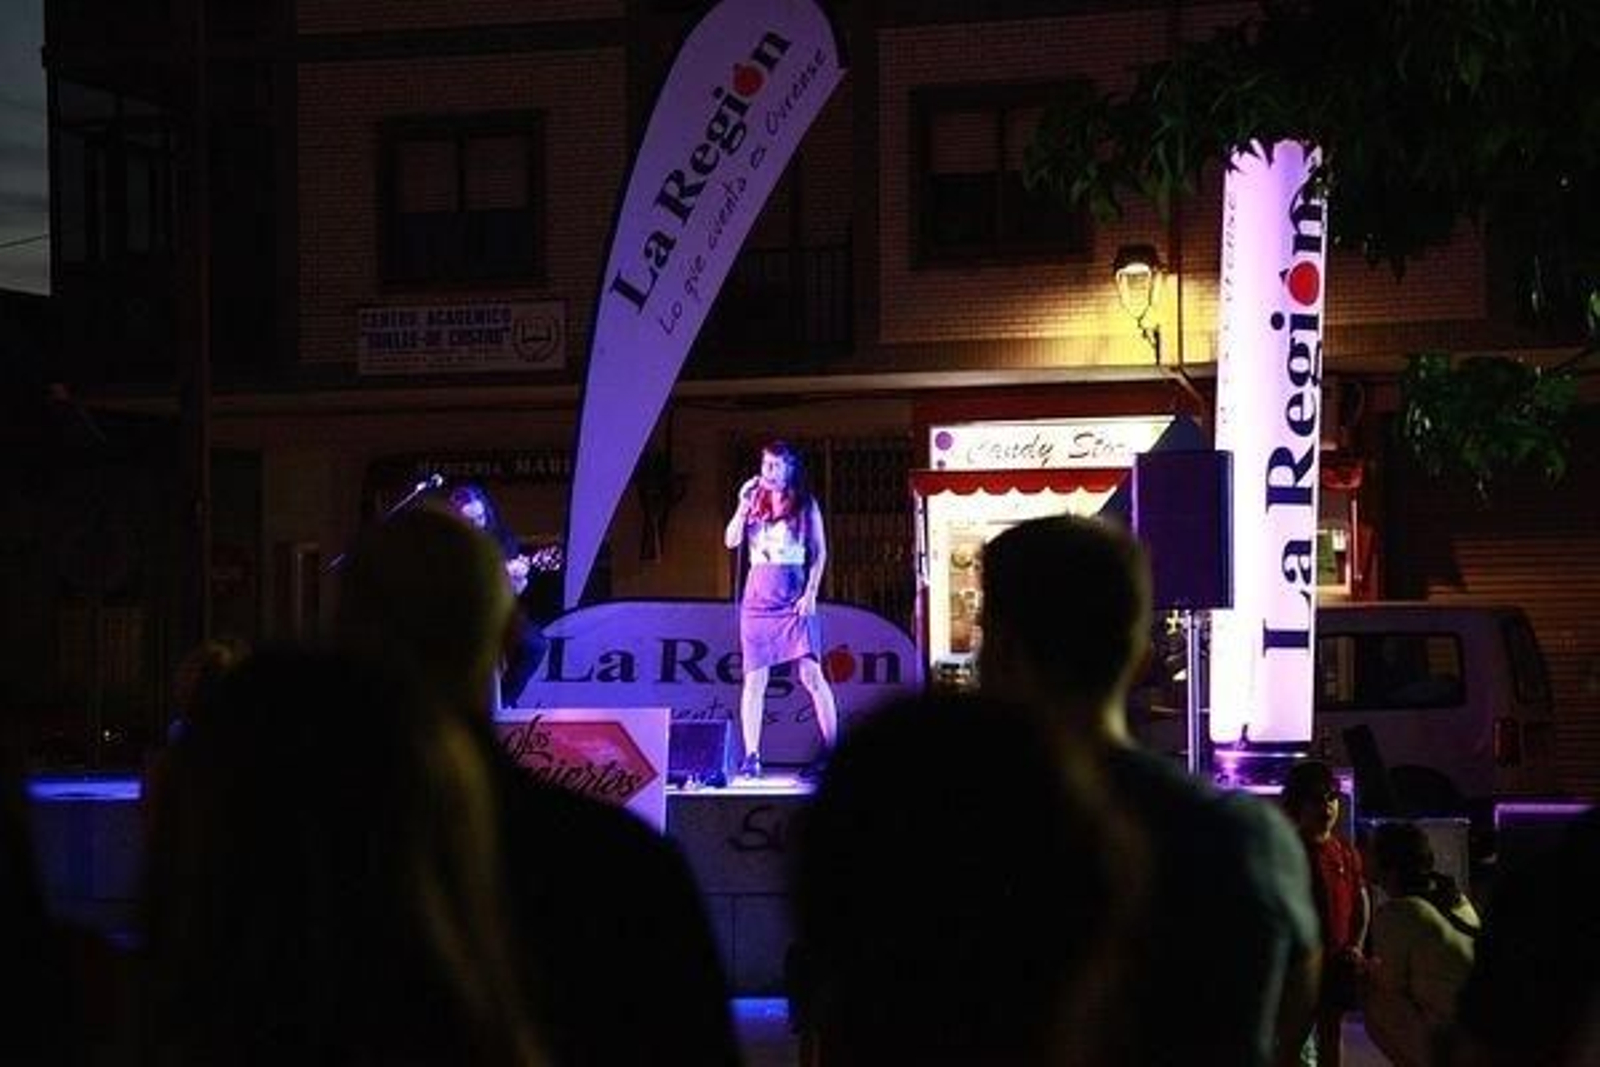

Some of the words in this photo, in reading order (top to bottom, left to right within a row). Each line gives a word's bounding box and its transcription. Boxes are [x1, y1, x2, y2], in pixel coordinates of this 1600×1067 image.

[609, 230, 677, 314] La
[654, 31, 792, 228] Región
[659, 301, 683, 335] Lo
[685, 254, 707, 301] que
[707, 176, 747, 250] cuenta
[766, 48, 825, 136] Ourense
[544, 636, 637, 683] La
[658, 638, 904, 698] Regón
[1262, 535, 1312, 658] La
